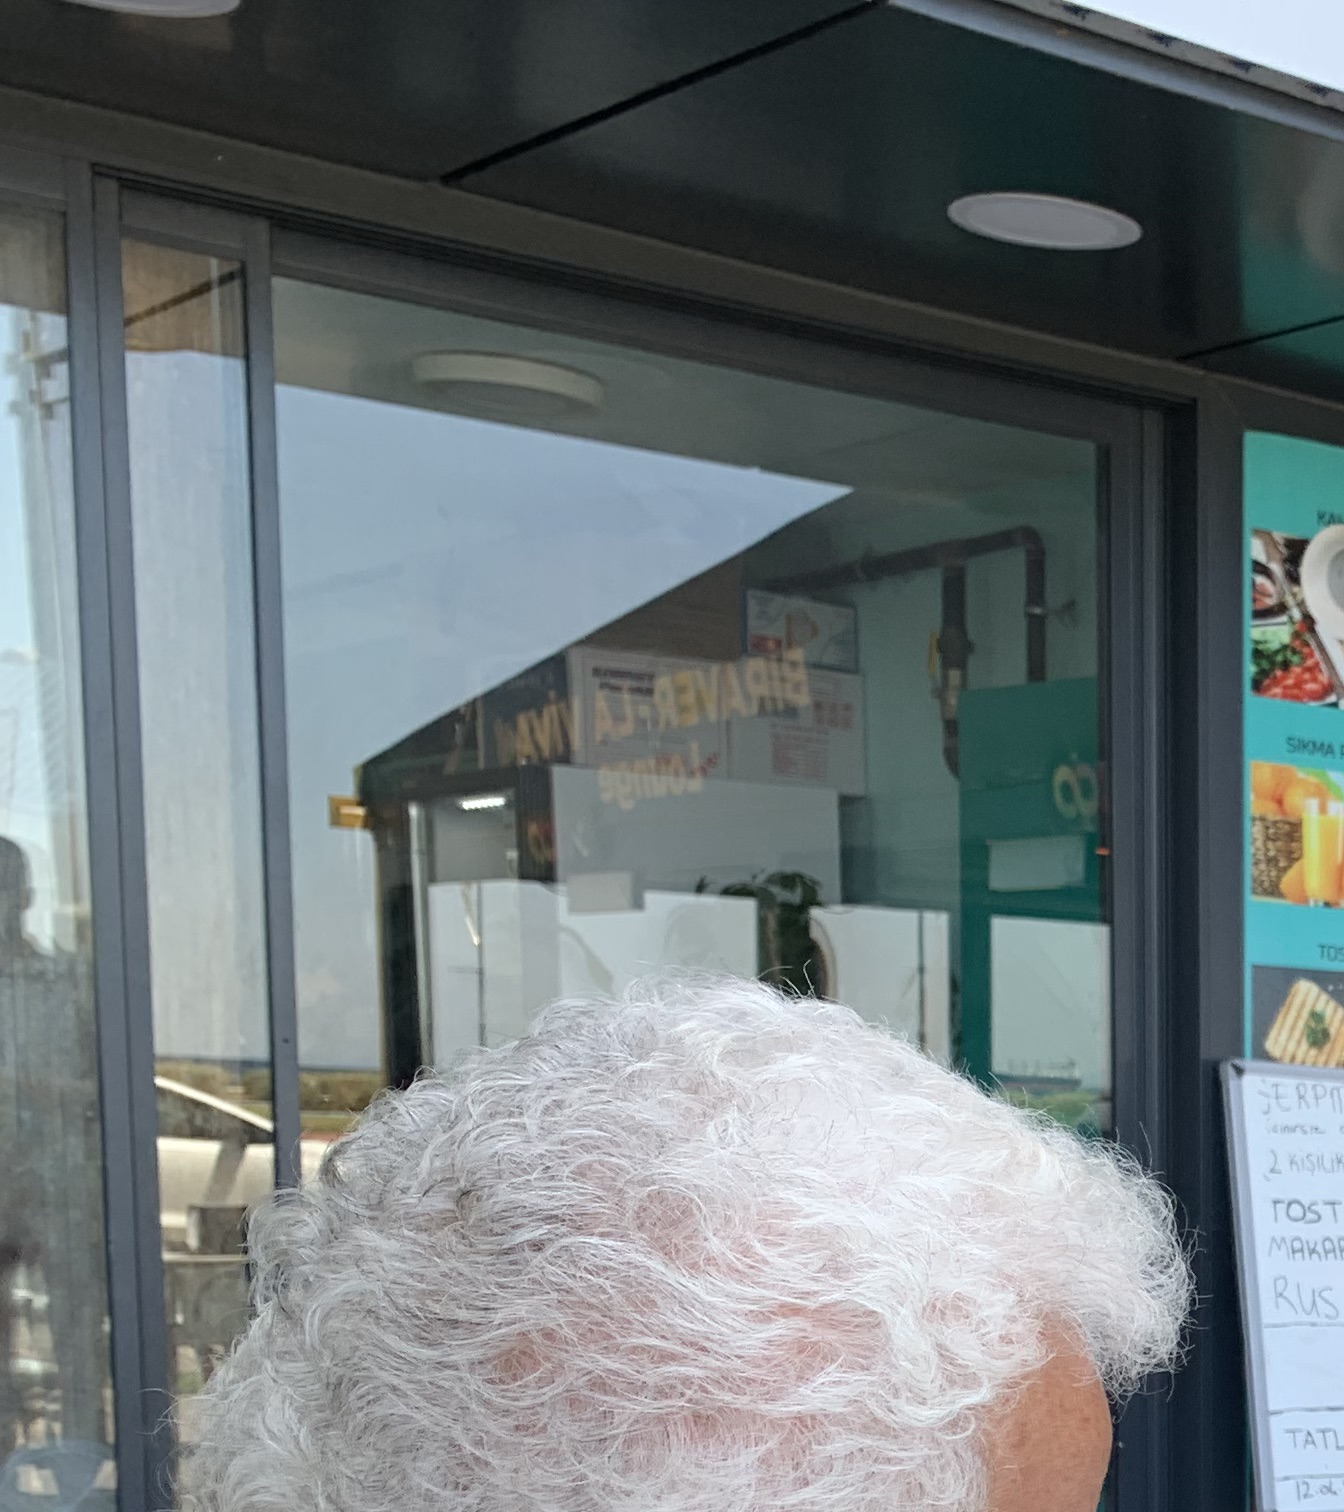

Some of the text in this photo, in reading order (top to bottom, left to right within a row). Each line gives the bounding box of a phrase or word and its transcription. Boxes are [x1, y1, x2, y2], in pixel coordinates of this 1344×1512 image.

[1286, 736, 1336, 760] SIKMA
[1271, 1199, 1342, 1225] TOST
[1272, 1275, 1340, 1321] RUS
